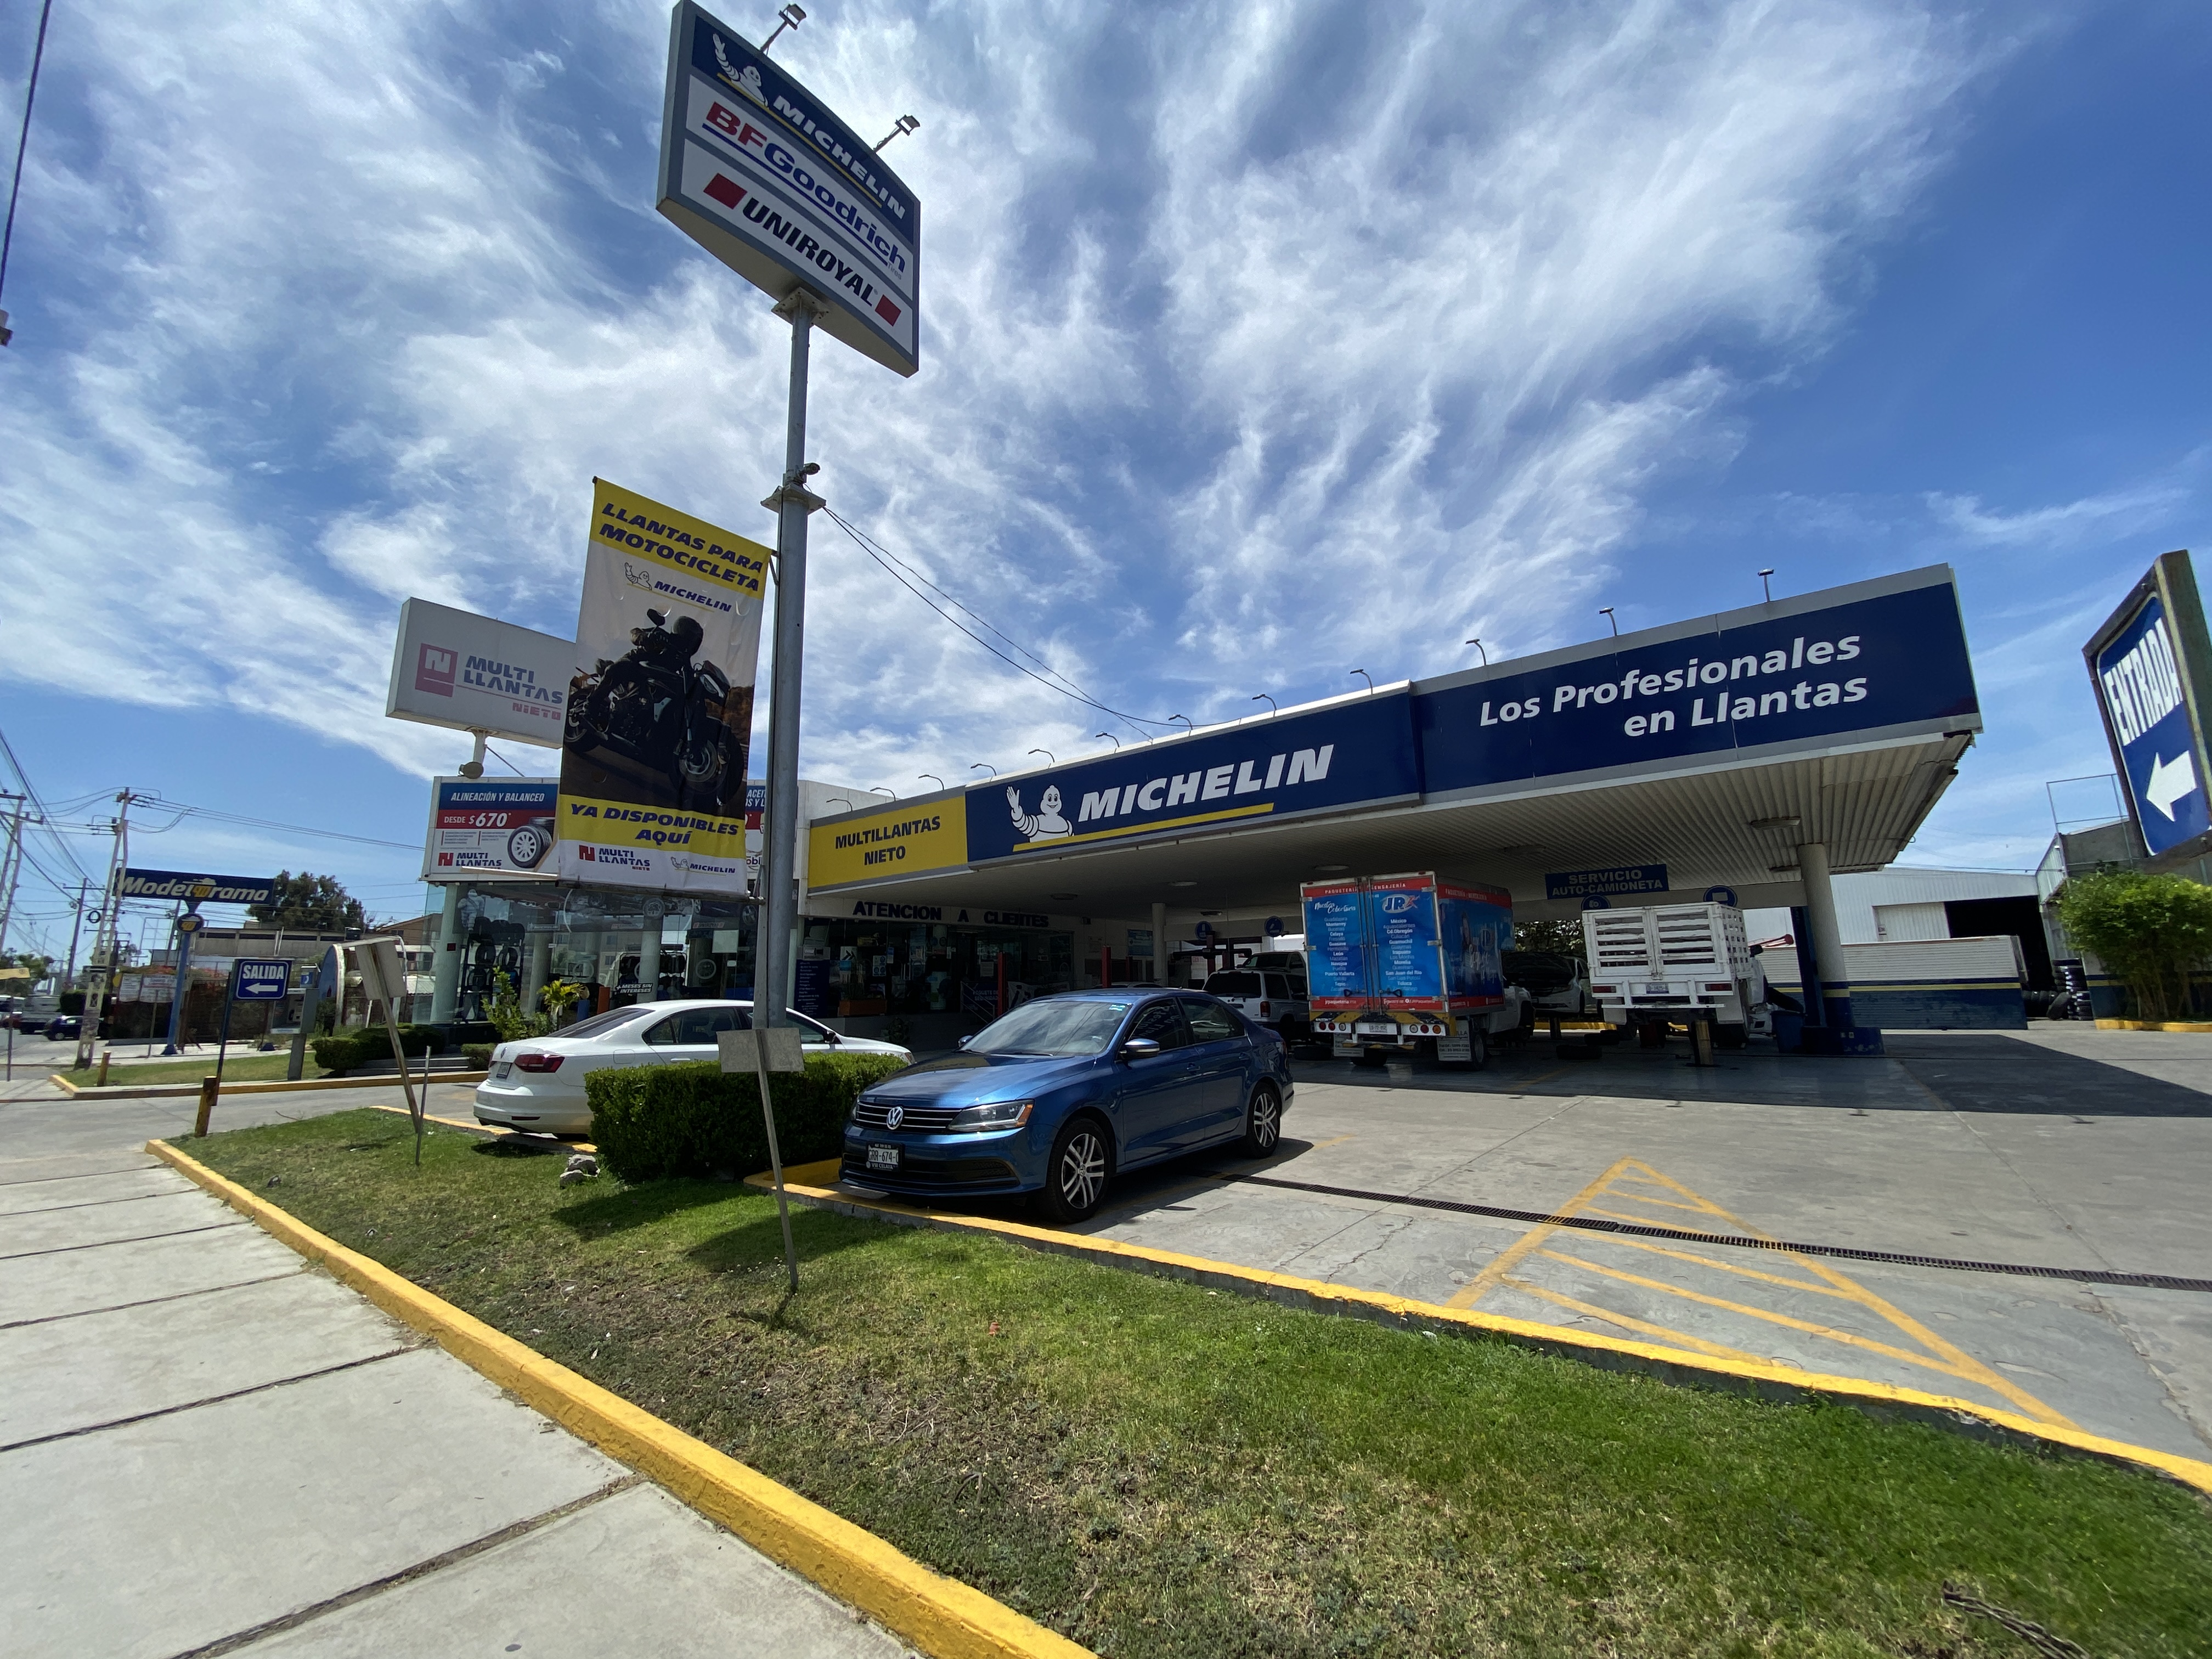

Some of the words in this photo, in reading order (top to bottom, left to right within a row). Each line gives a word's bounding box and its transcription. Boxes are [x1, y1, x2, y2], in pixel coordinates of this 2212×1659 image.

[772, 95, 906, 221] MICHELIN
[706, 101, 906, 272] BFGoodrich
[742, 196, 873, 307] UNIROYAL
[602, 503, 705, 550] LLANTAS
[708, 543, 764, 573] PARA
[599, 523, 760, 592] MOTOCICLETA
[654, 580, 732, 612] MICHELIN
[466, 655, 534, 684] MULTI
[1480, 701, 1541, 727] Los
[1553, 634, 1861, 713] Profesionales
[2103, 618, 2183, 746] ENTRADA
[464, 670, 563, 704] LLANTAS
[512, 702, 562, 721] NIETO
[1624, 709, 1675, 737] en
[1691, 676, 1867, 728] Llantas
[451, 792, 496, 802] ALINEACIÓN
[499, 793, 504, 802] Y
[505, 793, 545, 802] BALANCEO
[1077, 744, 1334, 822] MICHELIN
[571, 804, 598, 818] YA
[603, 808, 739, 836] DISPONIBLES
[835, 816, 940, 849] MULTILLANTAS
[599, 848, 634, 857] MULTI
[635, 829, 693, 845] AQUÍ
[599, 856, 650, 867] LLANTAS
[690, 863, 736, 874] MICHELIN
[864, 847, 906, 865] NIETO
[1552, 879, 1663, 896] AUTO-CAMIONETA
[1568, 869, 1642, 884] SERVICIO
[853, 901, 942, 921] ATENCION
[957, 910, 969, 922] A
[242, 965, 285, 980] SALIDA
